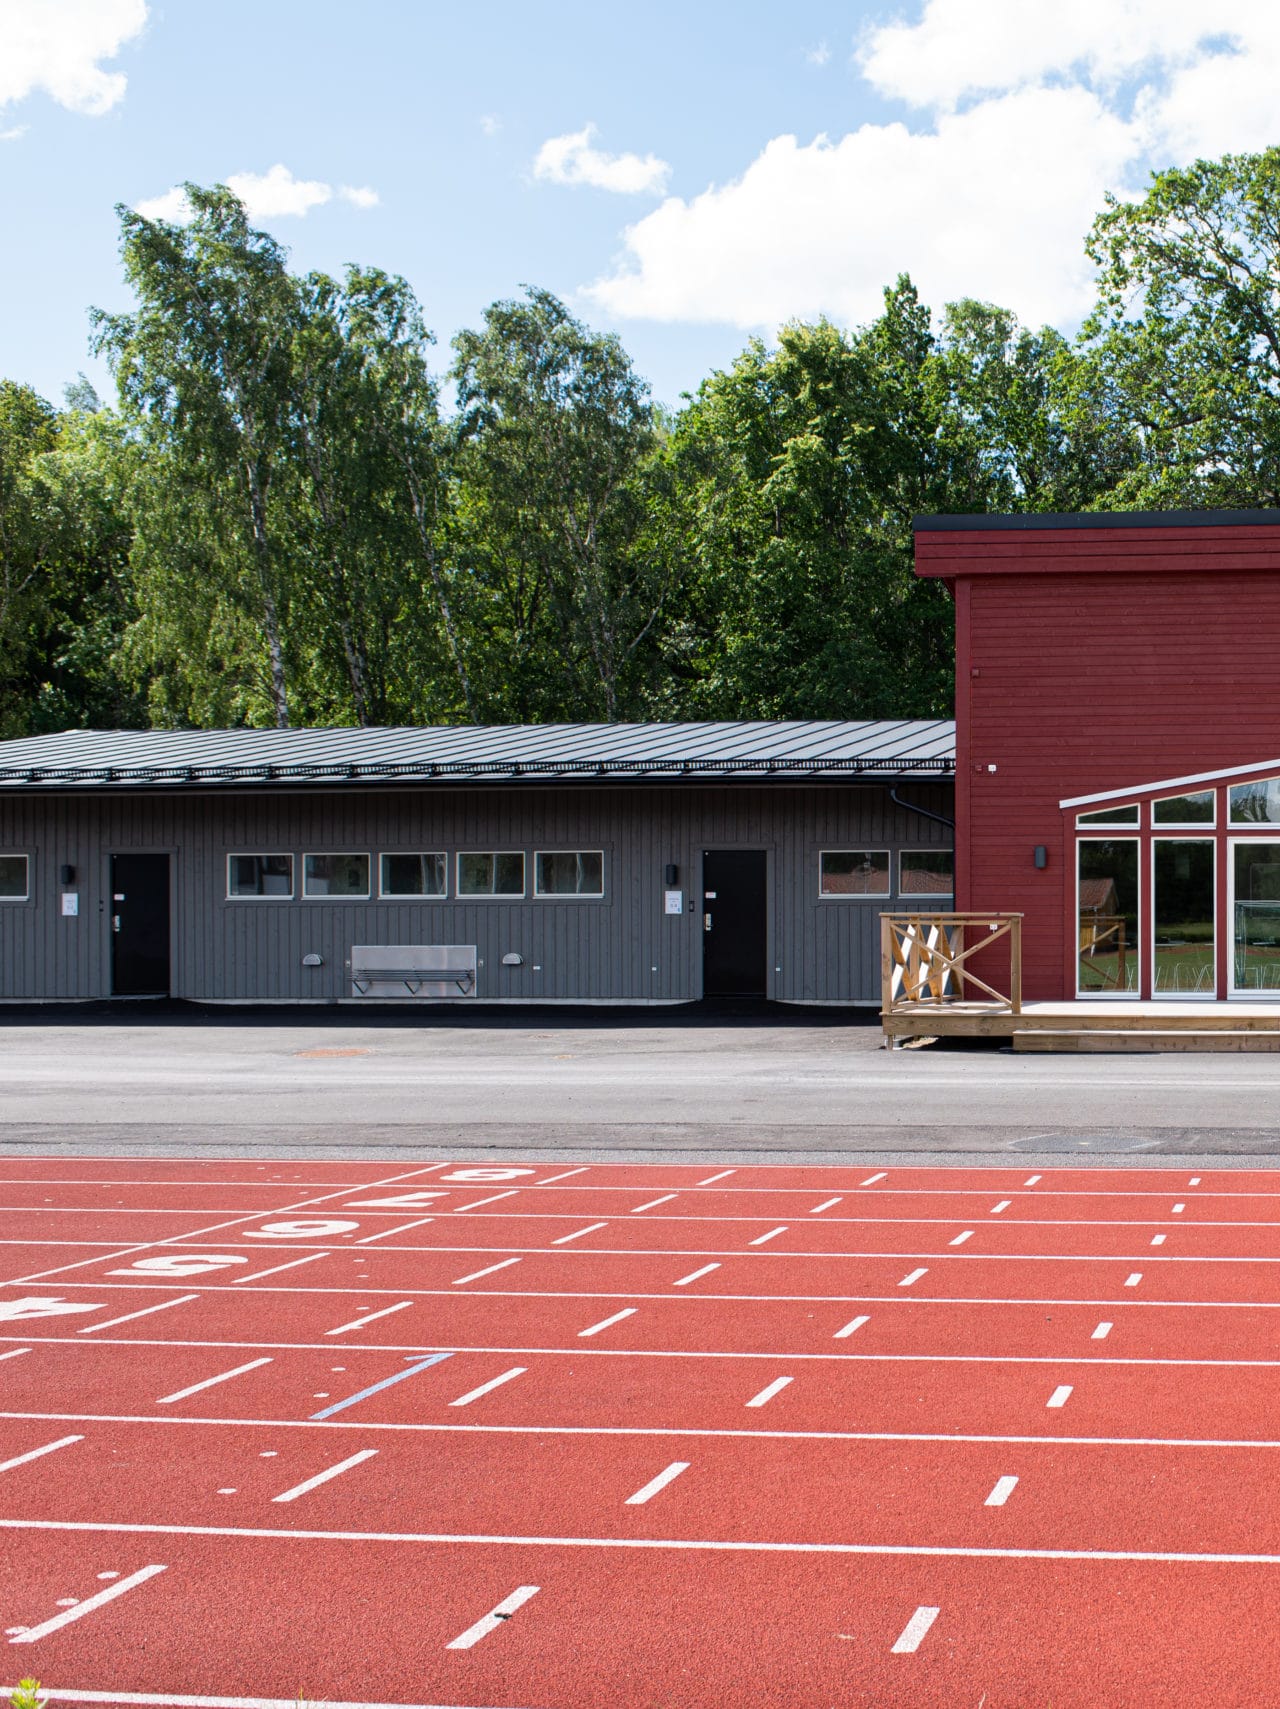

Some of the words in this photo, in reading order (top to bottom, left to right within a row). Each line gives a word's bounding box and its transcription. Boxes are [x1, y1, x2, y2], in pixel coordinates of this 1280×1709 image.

[440, 1168, 536, 1181] 8
[342, 1192, 451, 1208] 7
[242, 1220, 359, 1239] 6
[104, 1255, 248, 1276] 5
